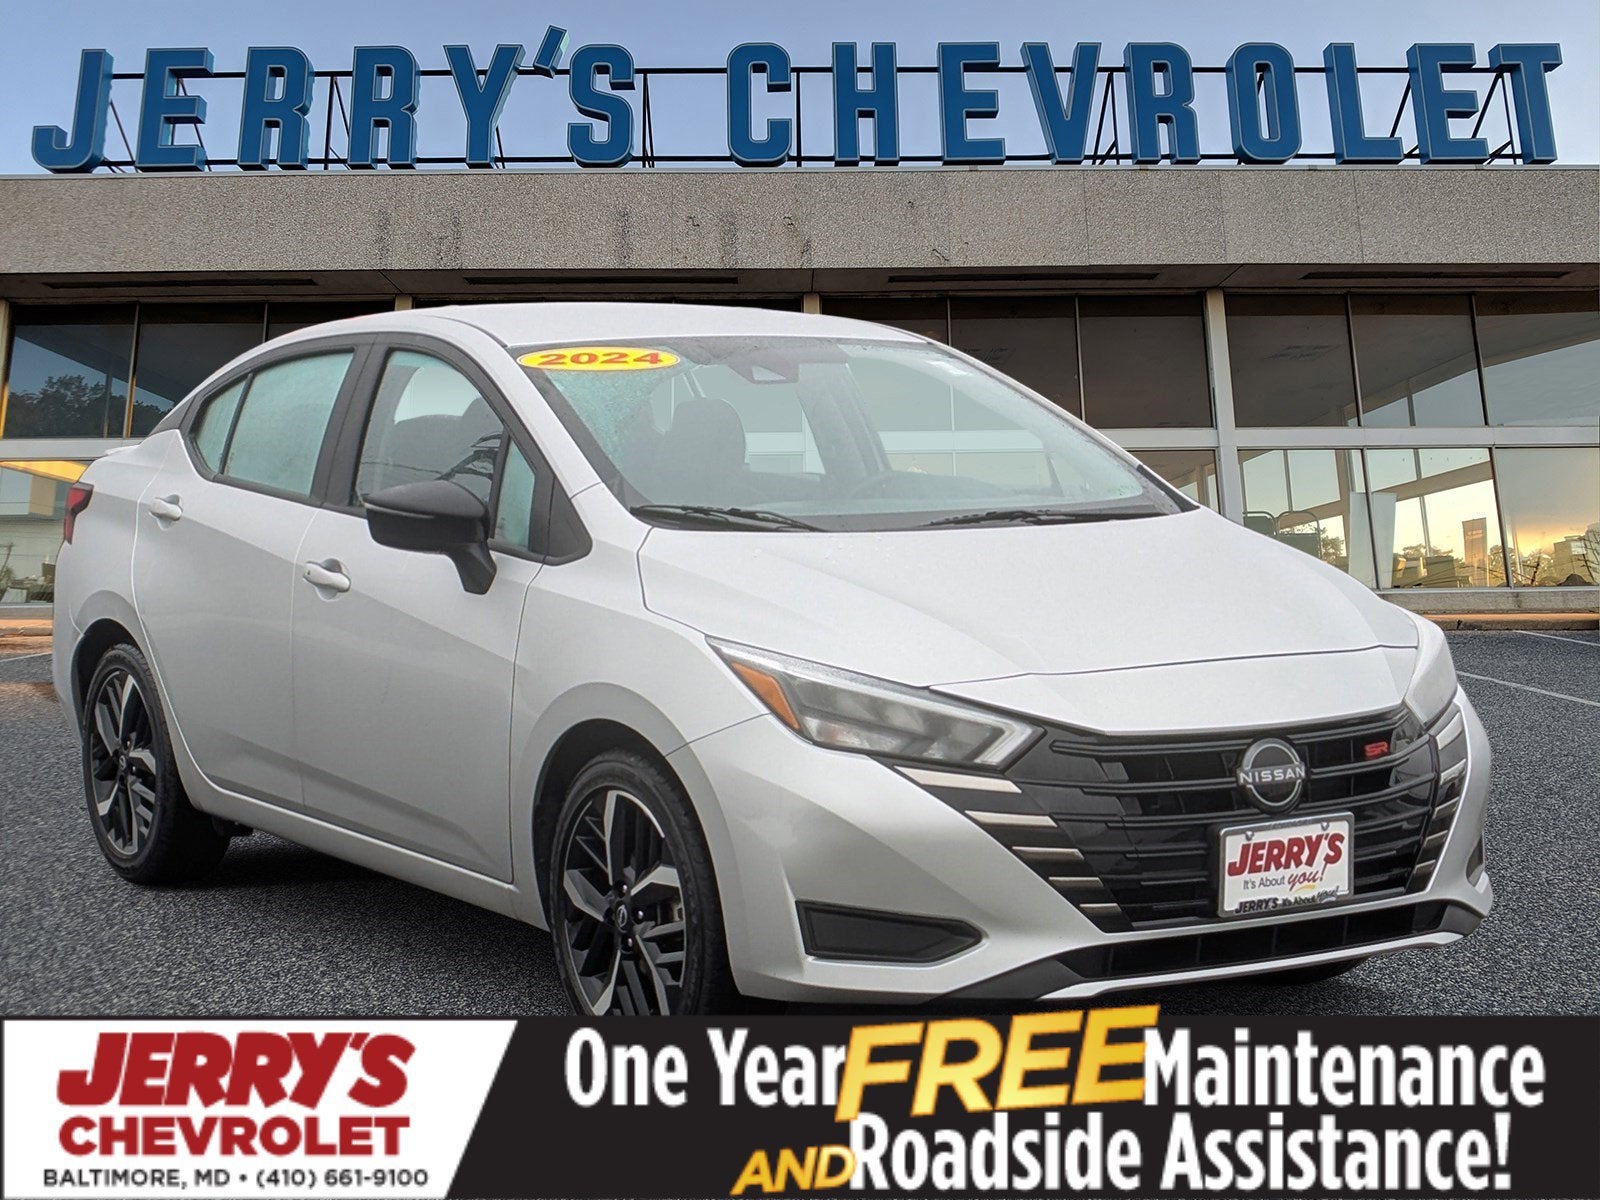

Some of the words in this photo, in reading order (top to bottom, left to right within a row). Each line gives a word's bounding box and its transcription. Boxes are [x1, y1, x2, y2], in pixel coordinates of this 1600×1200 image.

[31, 25, 635, 173] JERRY'S
[726, 42, 1563, 165] CHEVROLET
[538, 351, 663, 366] 2024
[1365, 741, 1388, 758] SR
[1239, 767, 1306, 784] NISSAN
[1227, 833, 1345, 876] JERRY'S
[1243, 879, 1257, 890] It's
[1258, 876, 1286, 888] About
[1287, 863, 1326, 891] you!
